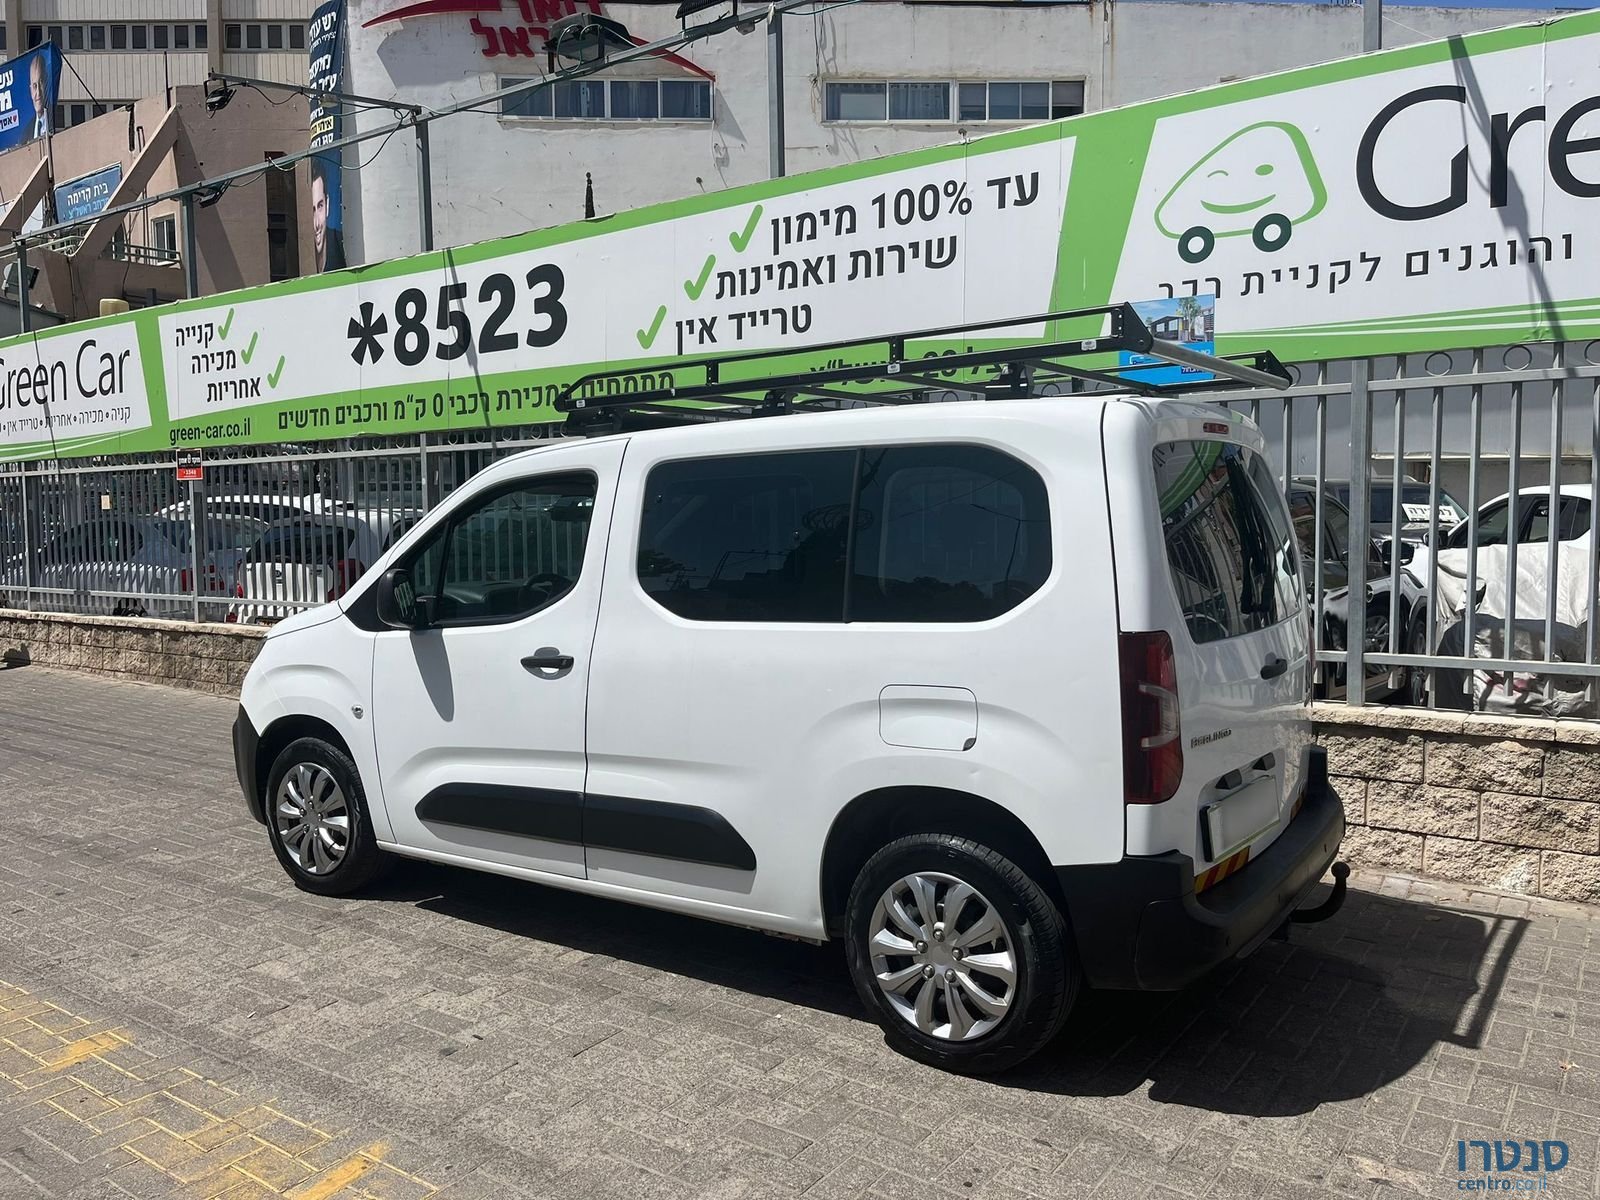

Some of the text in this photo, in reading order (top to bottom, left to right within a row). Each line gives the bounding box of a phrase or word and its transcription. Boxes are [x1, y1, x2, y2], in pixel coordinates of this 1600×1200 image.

[771, 171, 1040, 256] עד 100% מימון
[715, 235, 958, 300] שירות ואמינות
[1404, 233, 1573, 277] והוגנים
[1240, 251, 1382, 296] לקניית
[175, 322, 214, 349] קנייה
[675, 303, 813, 356] טרייד אין
[0, 339, 131, 411] reen Car
[191, 349, 236, 375] מכירה
[206, 376, 261, 403] אחריות
[79, 409, 104, 425] מכירה
[111, 406, 131, 424] קניה
[335, 401, 388, 425] ורכבים
[432, 392, 444, 418] 0
[448, 391, 490, 416] רכבי
[169, 417, 251, 446] green-car.co.il
[278, 407, 330, 430] חדשים
